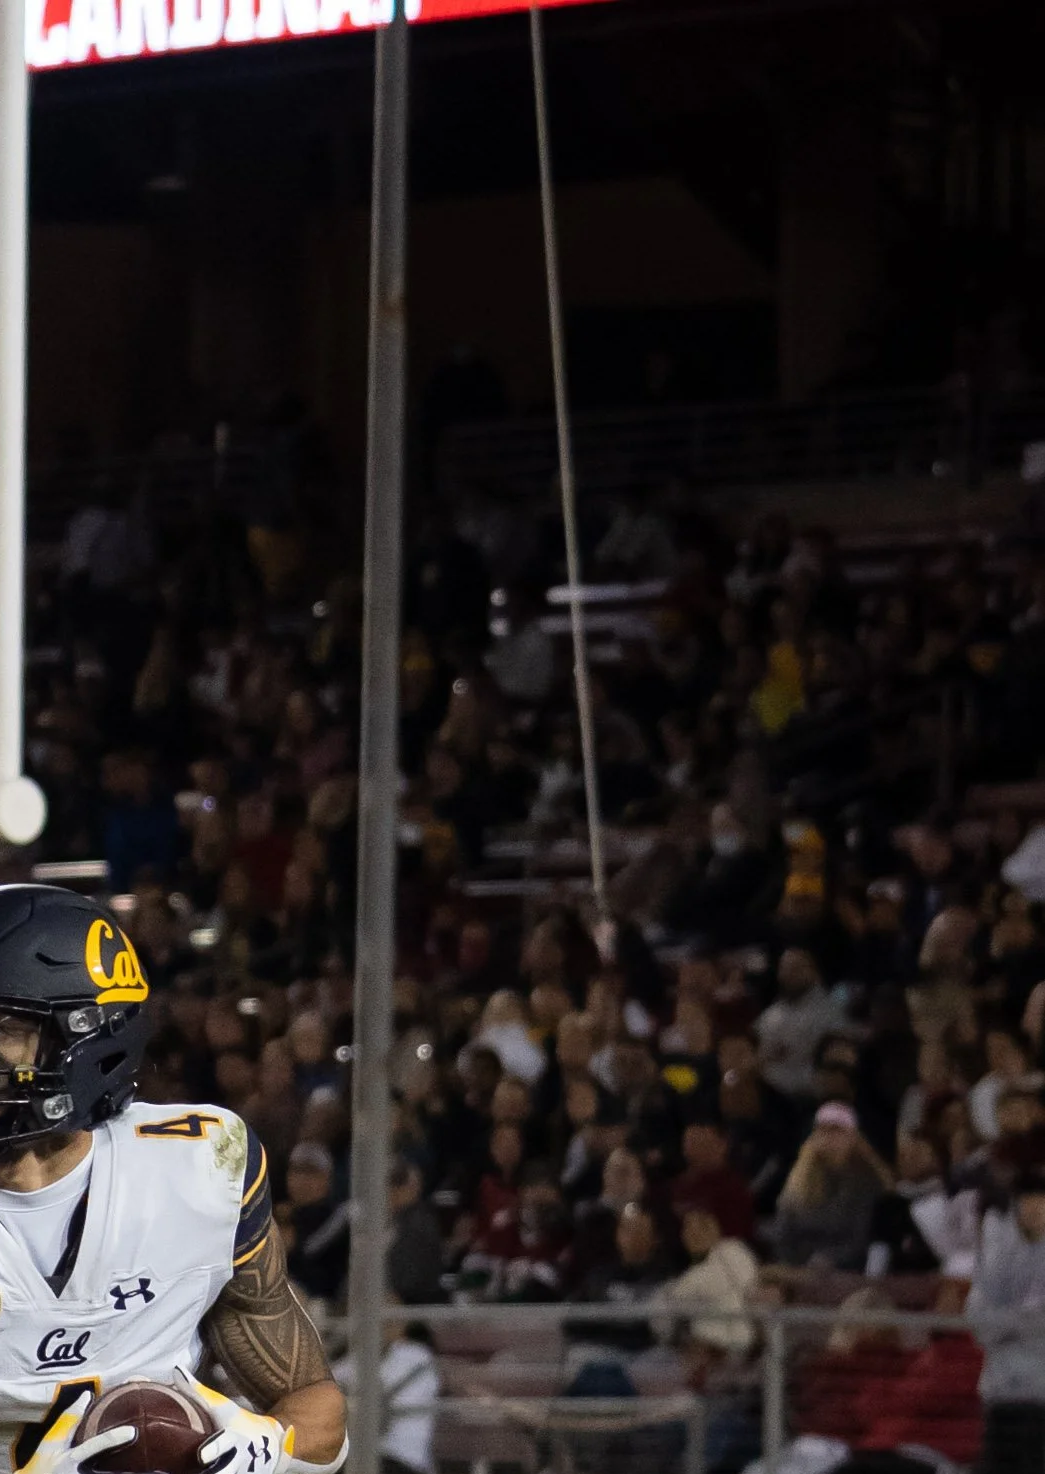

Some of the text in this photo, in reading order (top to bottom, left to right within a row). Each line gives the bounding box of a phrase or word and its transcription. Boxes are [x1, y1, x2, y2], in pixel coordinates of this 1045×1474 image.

[84, 919, 149, 1004] Cal
[135, 1111, 224, 1139] 4
[36, 1328, 91, 1371] Cal
